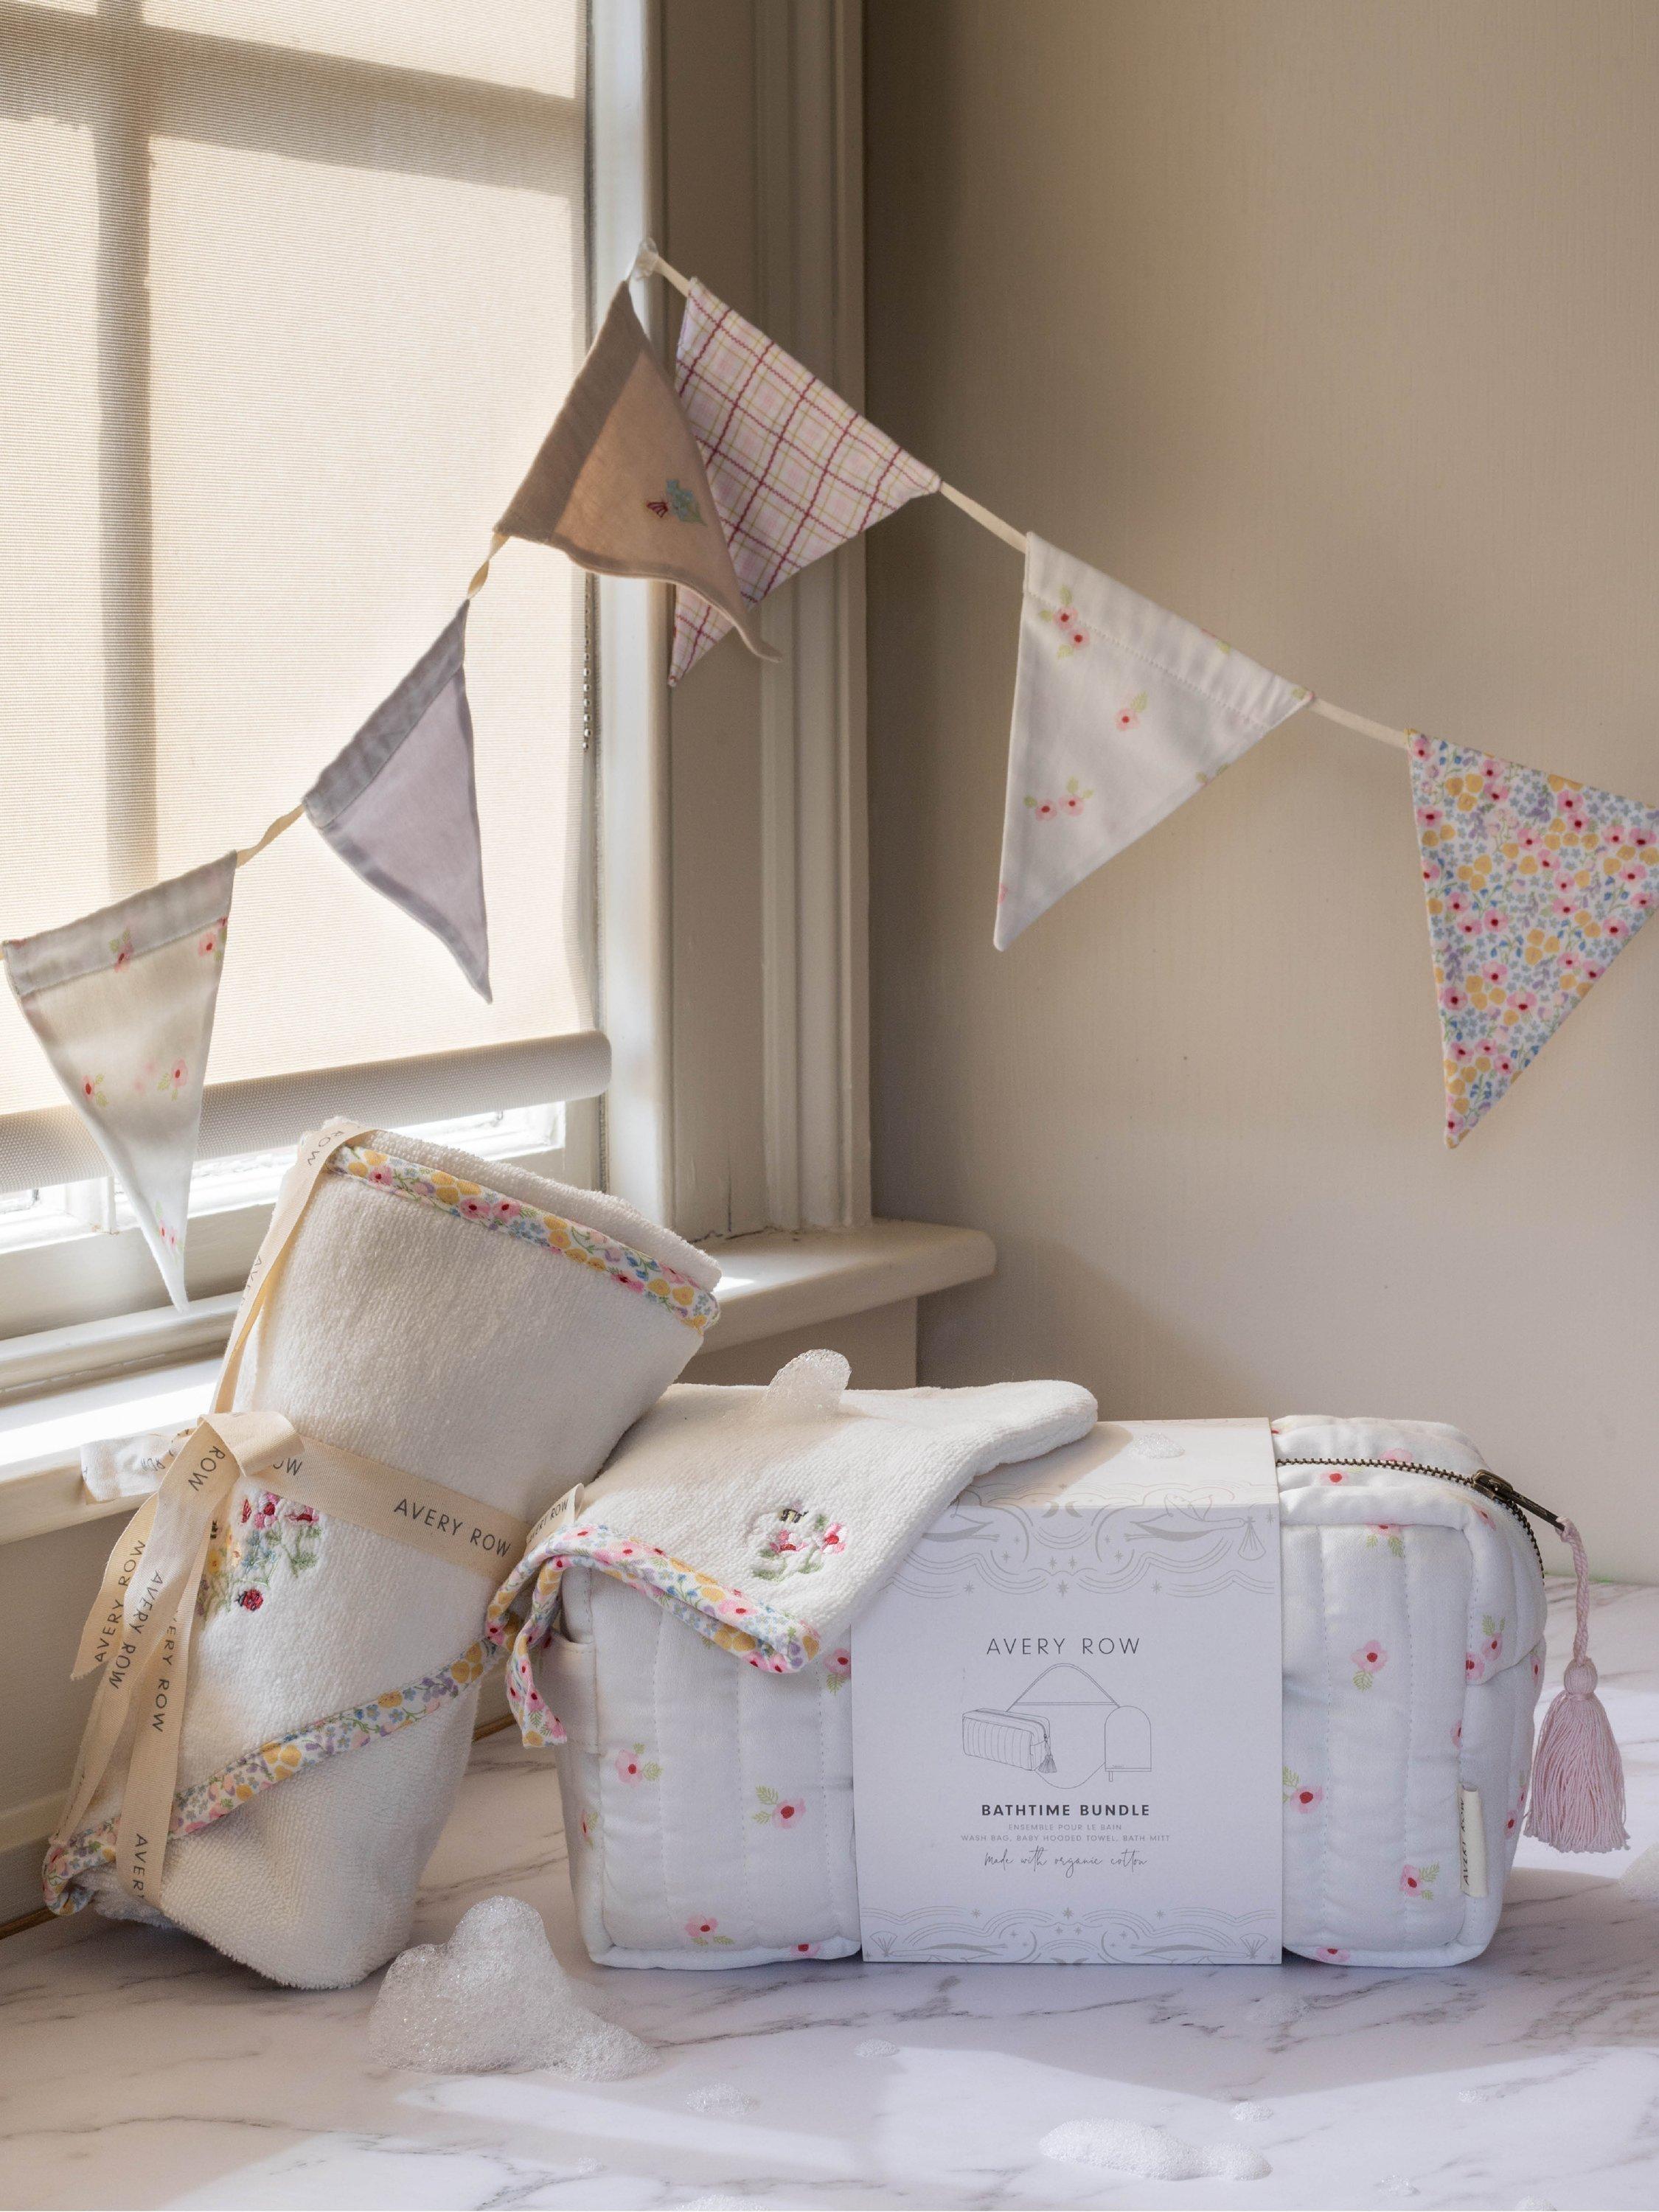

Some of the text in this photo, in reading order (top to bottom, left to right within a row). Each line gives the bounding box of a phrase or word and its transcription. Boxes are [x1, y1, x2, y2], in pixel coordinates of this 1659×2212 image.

[188, 1445, 226, 1492] ROW
[394, 1498, 512, 1558] AVERY ROW
[94, 1540, 146, 1662] AVERY ROW
[108, 1570, 163, 1689] AVERY ROW
[986, 1637, 1141, 1656] AVERY ROW
[152, 1678, 170, 1732] ROW
[981, 1804, 1150, 1817] BATHTIME BUNDLE
[990, 1834, 1012, 1843] BAG,
[1020, 1846, 1048, 1871] with
[1054, 1857, 1103, 1878] organic
[1110, 1849, 1148, 1872] cotton
